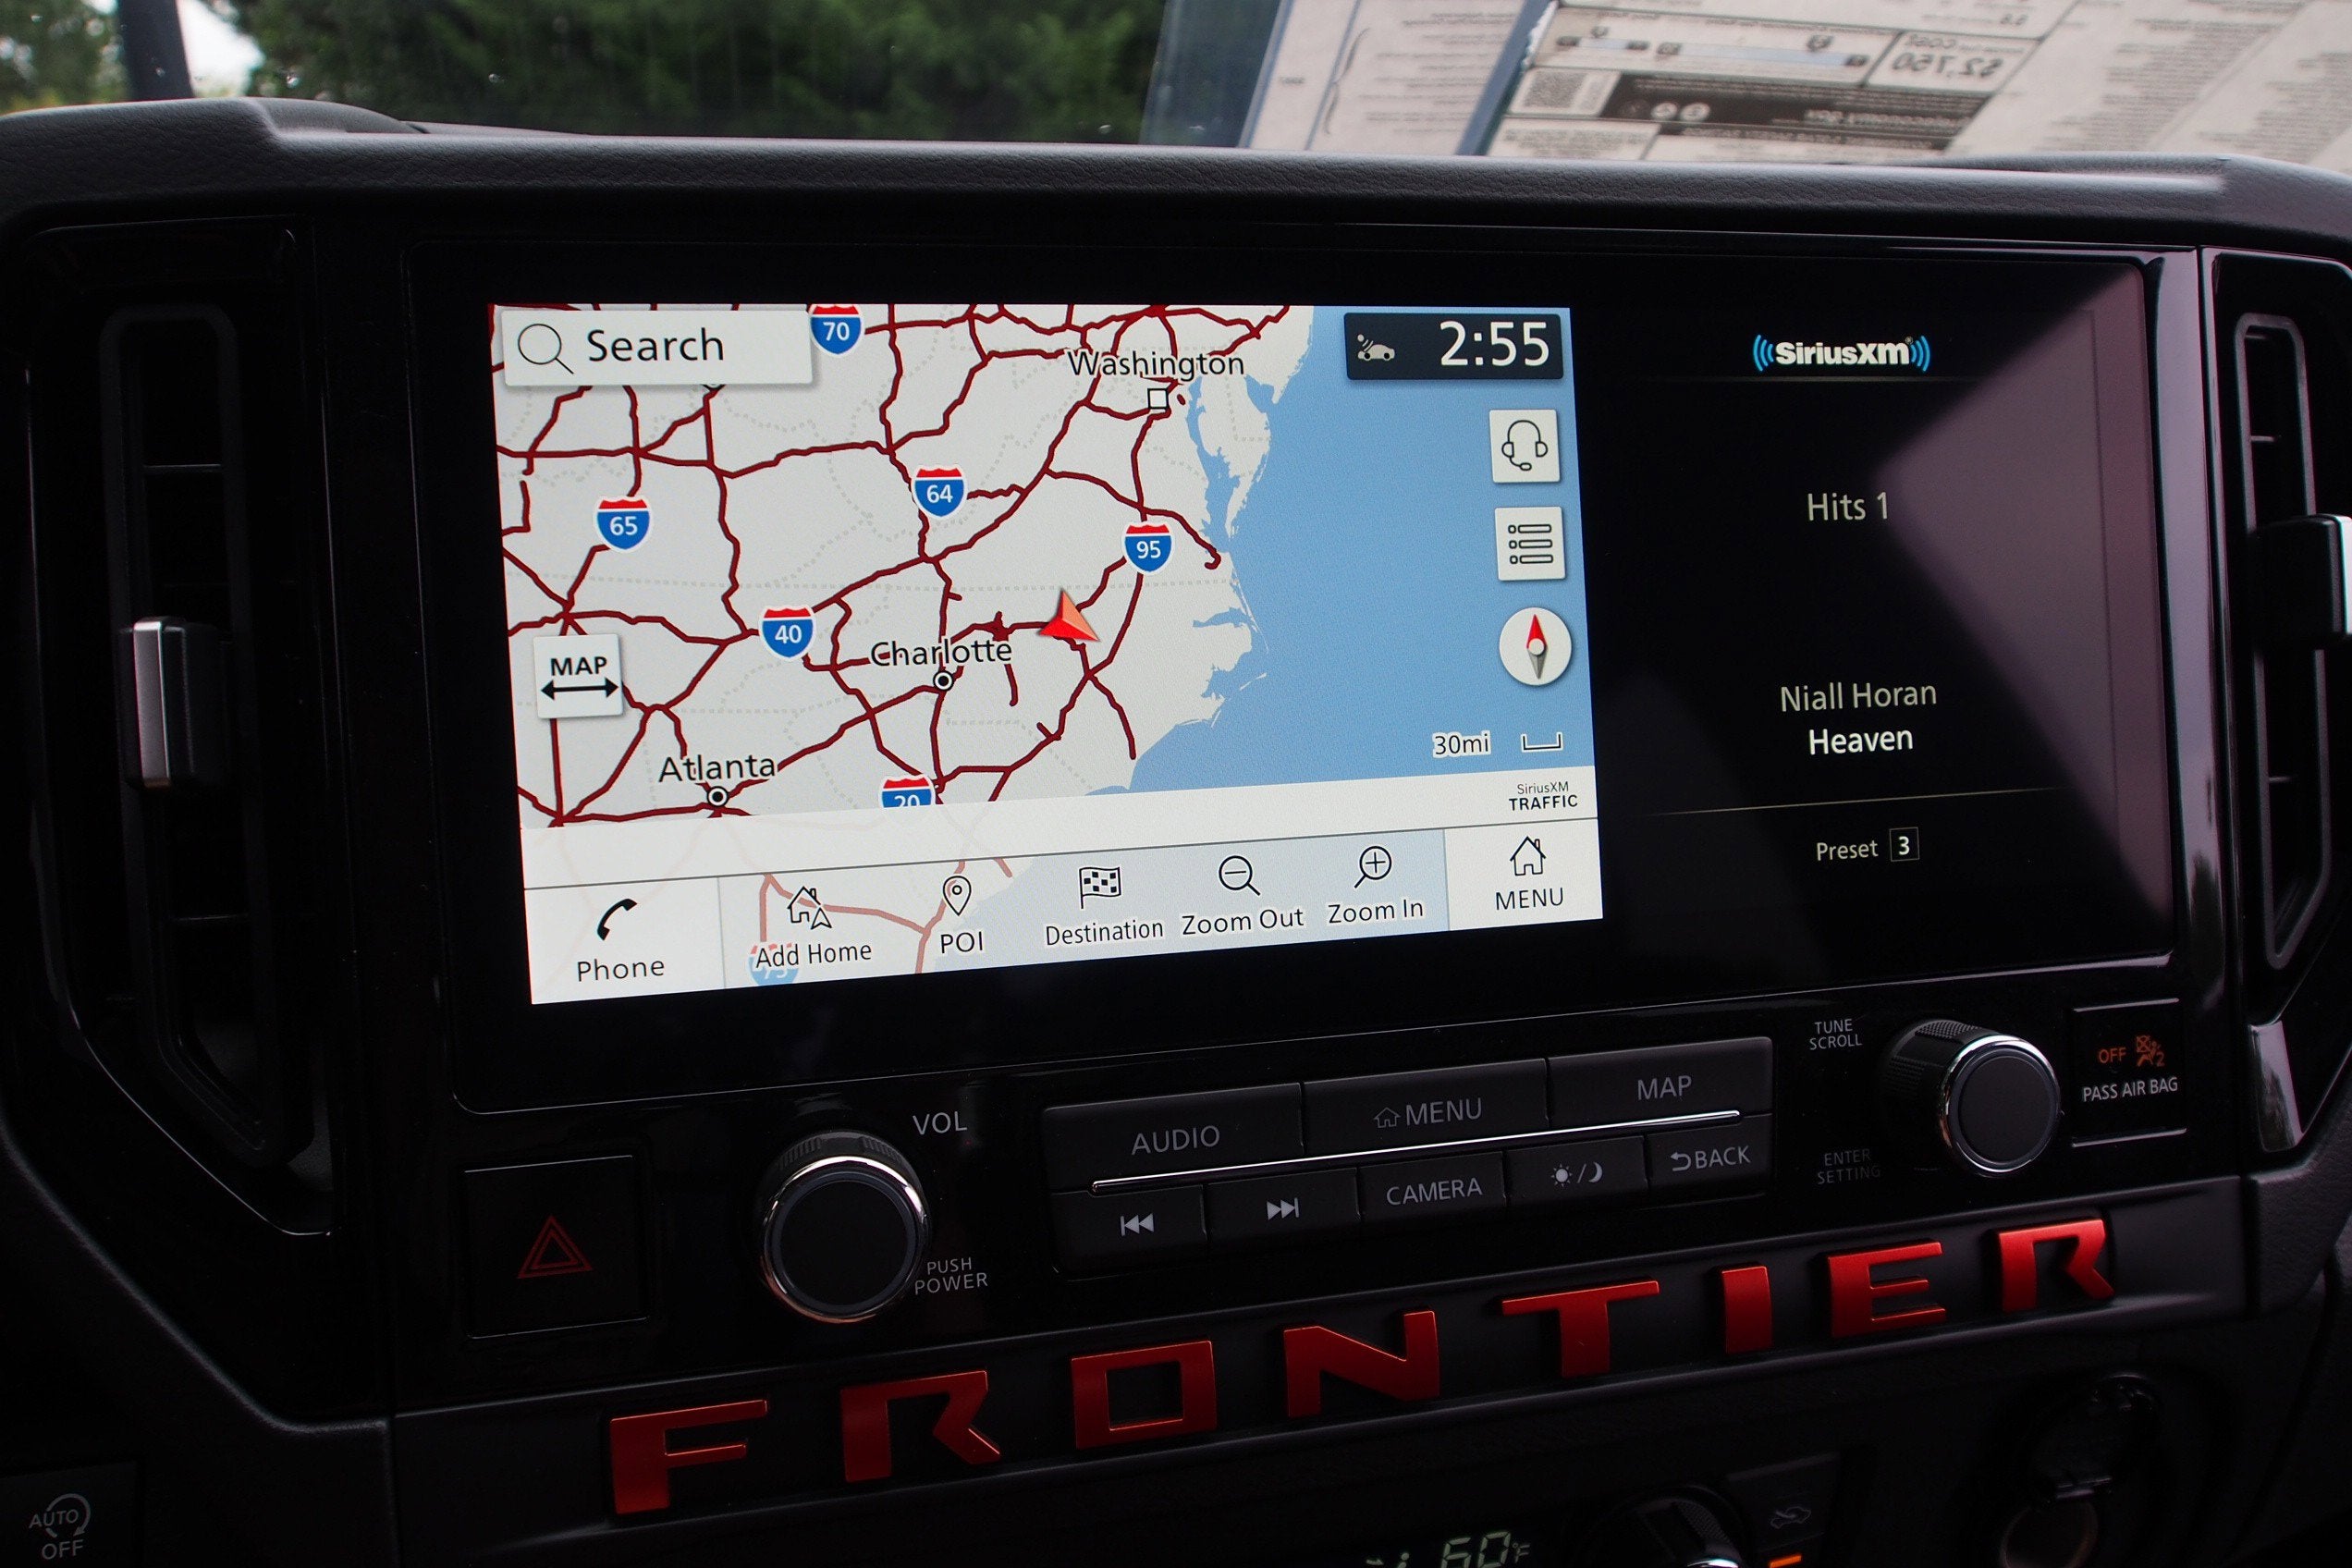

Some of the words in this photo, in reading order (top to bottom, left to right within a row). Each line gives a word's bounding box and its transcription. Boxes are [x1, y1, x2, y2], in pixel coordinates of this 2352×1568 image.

[823, 321, 851, 341] 70
[587, 326, 726, 362] Search
[1439, 321, 1551, 368] 2:55
[1067, 350, 1245, 382] Washington
[926, 484, 953, 504] 64
[1807, 493, 1866, 521] Hits
[1877, 492, 1889, 520] 1
[609, 516, 638, 536] 65
[1136, 540, 1162, 560] 95
[775, 624, 802, 644] 40
[550, 655, 608, 677] MAP
[871, 640, 1012, 668] Charlotte
[1781, 682, 1844, 712] Niall
[1853, 681, 1938, 709] Horan
[1435, 733, 1490, 754] 30mi
[1809, 727, 1914, 755] Heaven
[659, 753, 777, 782] Atlanta
[1517, 781, 1569, 795] SiriusXM
[1509, 795, 1578, 812] TRAFFIC
[1817, 839, 1879, 861] Preset
[1899, 836, 1910, 855] 3
[1496, 888, 1564, 911] MENU
[1182, 913, 1252, 937] Zoom
[1259, 908, 1305, 931] Out
[1329, 902, 1396, 925] Zoom
[1403, 899, 1424, 919] In
[940, 932, 984, 954] POI
[1046, 918, 1164, 947] Destination
[756, 944, 800, 969] Add
[808, 944, 872, 966] Home
[577, 957, 666, 982] Phone
[1814, 1018, 1854, 1035] TUNE
[1809, 1033, 1862, 1051] SCROLL
[2098, 1047, 2127, 1064] OFF
[1637, 1075, 1692, 1101] MAP
[2083, 1084, 2117, 1102] PASS
[2122, 1080, 2146, 1097] AIR
[2150, 1076, 2178, 1095] BAG
[913, 1111, 967, 1135] VOL
[1406, 1097, 1482, 1126] MENU
[1132, 1125, 1219, 1156] AUDIO
[1696, 1145, 1750, 1169] BACK
[1823, 1147, 1871, 1167] ENTER
[1816, 1164, 1881, 1185] SETTING
[1386, 1177, 1482, 1206] CAMERA
[927, 1257, 972, 1274] PUSH
[914, 1272, 988, 1294] POWER
[609, 1218, 2114, 1514] FRONTIER
[29, 1509, 79, 1528] AUTO
[42, 1539, 84, 1560] OFF
